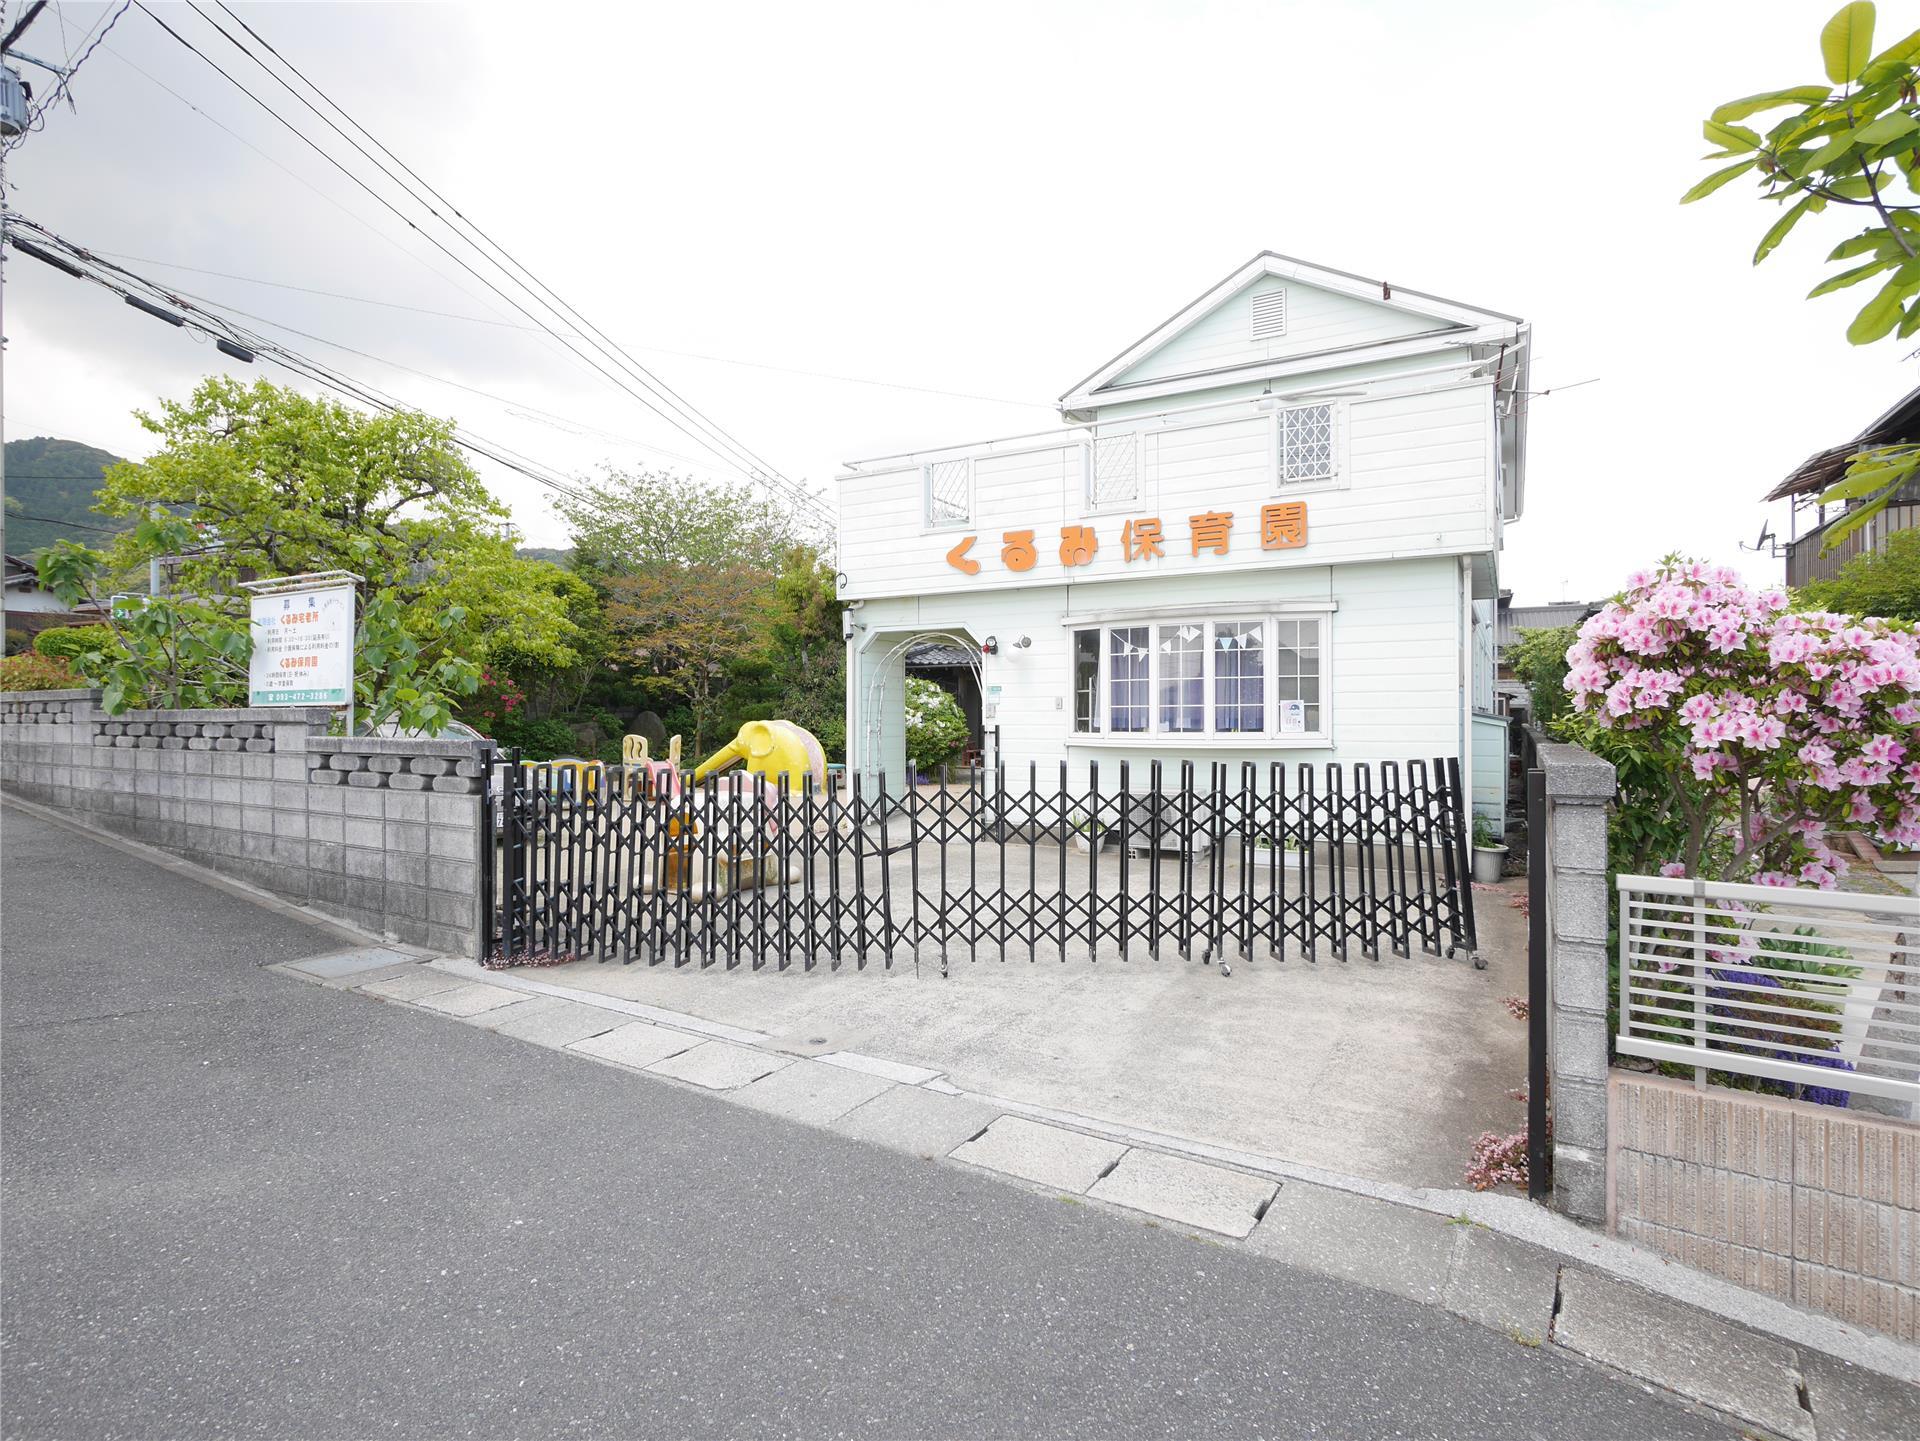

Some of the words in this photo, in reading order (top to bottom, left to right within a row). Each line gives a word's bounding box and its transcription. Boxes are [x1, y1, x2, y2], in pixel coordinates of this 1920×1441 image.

[946, 501, 1308, 575] くるみ保育園
